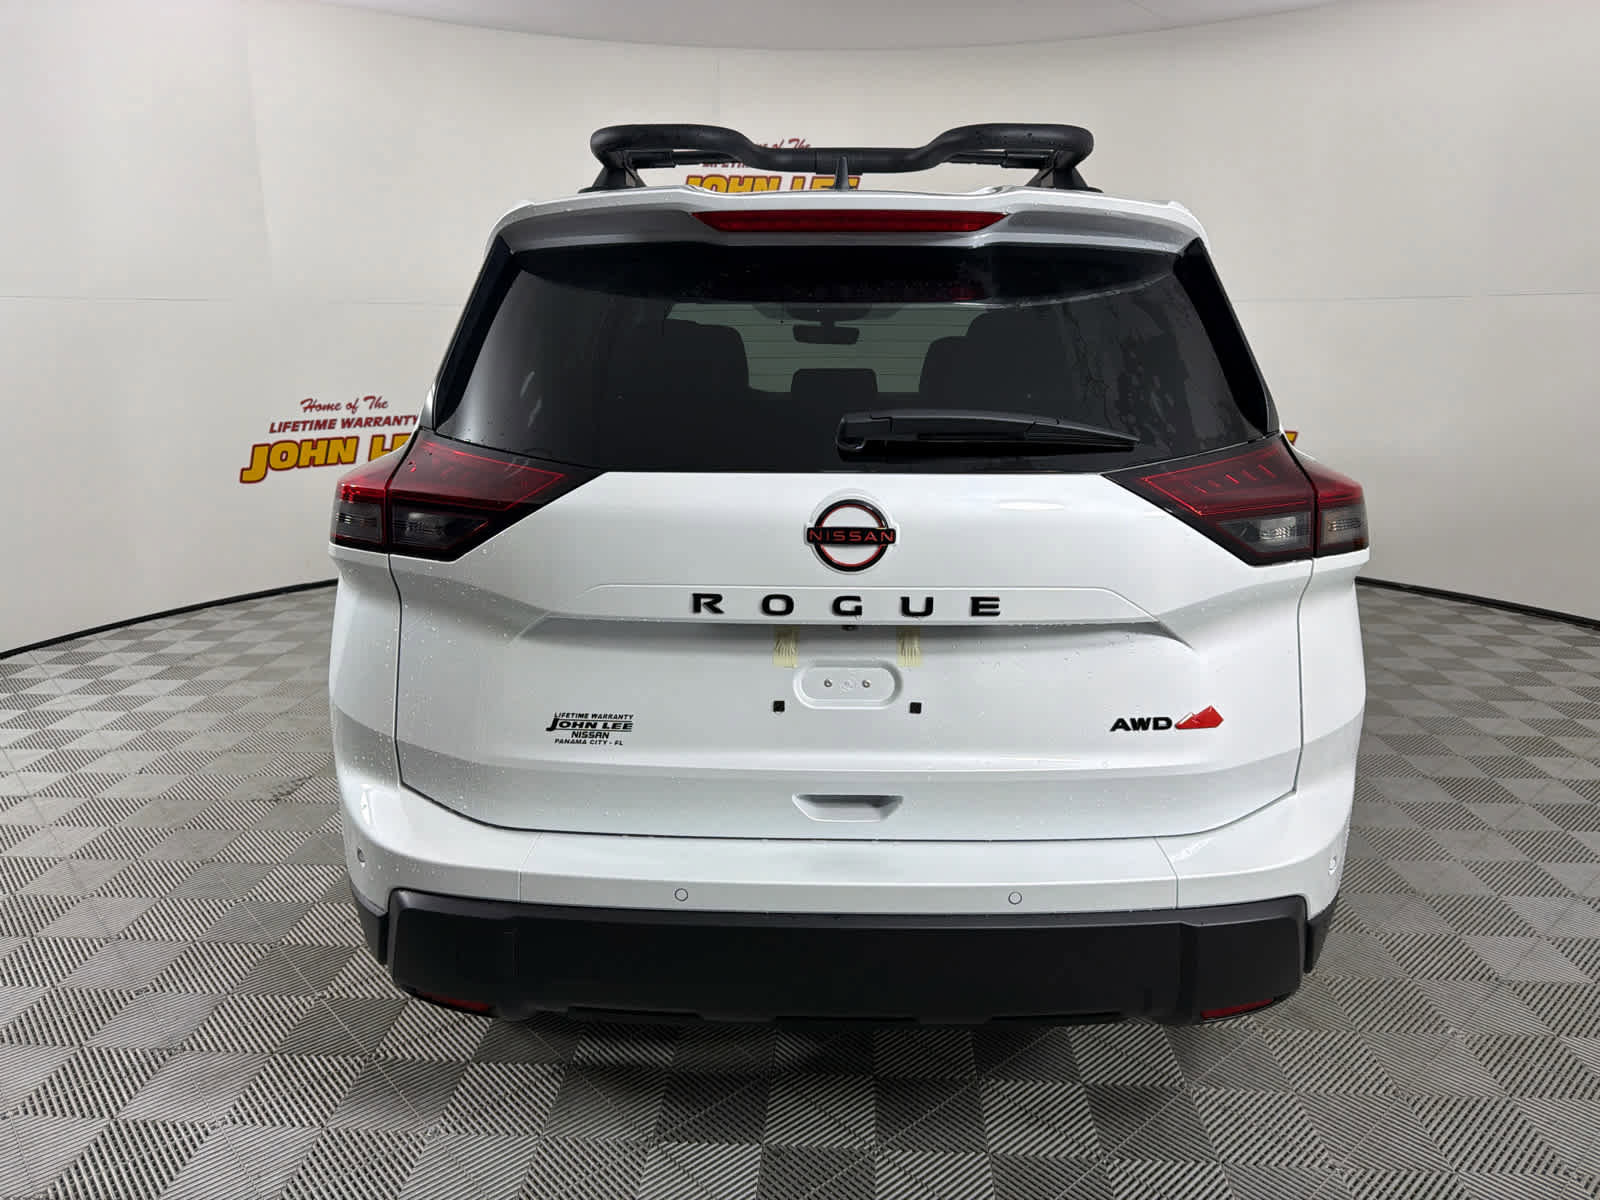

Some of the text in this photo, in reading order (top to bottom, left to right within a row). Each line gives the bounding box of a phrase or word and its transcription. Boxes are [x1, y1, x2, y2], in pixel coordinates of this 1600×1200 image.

[300, 395, 389, 415] Home of The
[269, 414, 418, 433] LIFETIME WARRANTY
[239, 435, 360, 484] JOHN
[808, 528, 896, 544] NISSAN
[692, 592, 1001, 618] ROGUE
[545, 717, 634, 732] JOHN LEE
[1109, 716, 1173, 732] AWD
[571, 731, 610, 739] NISSAN
